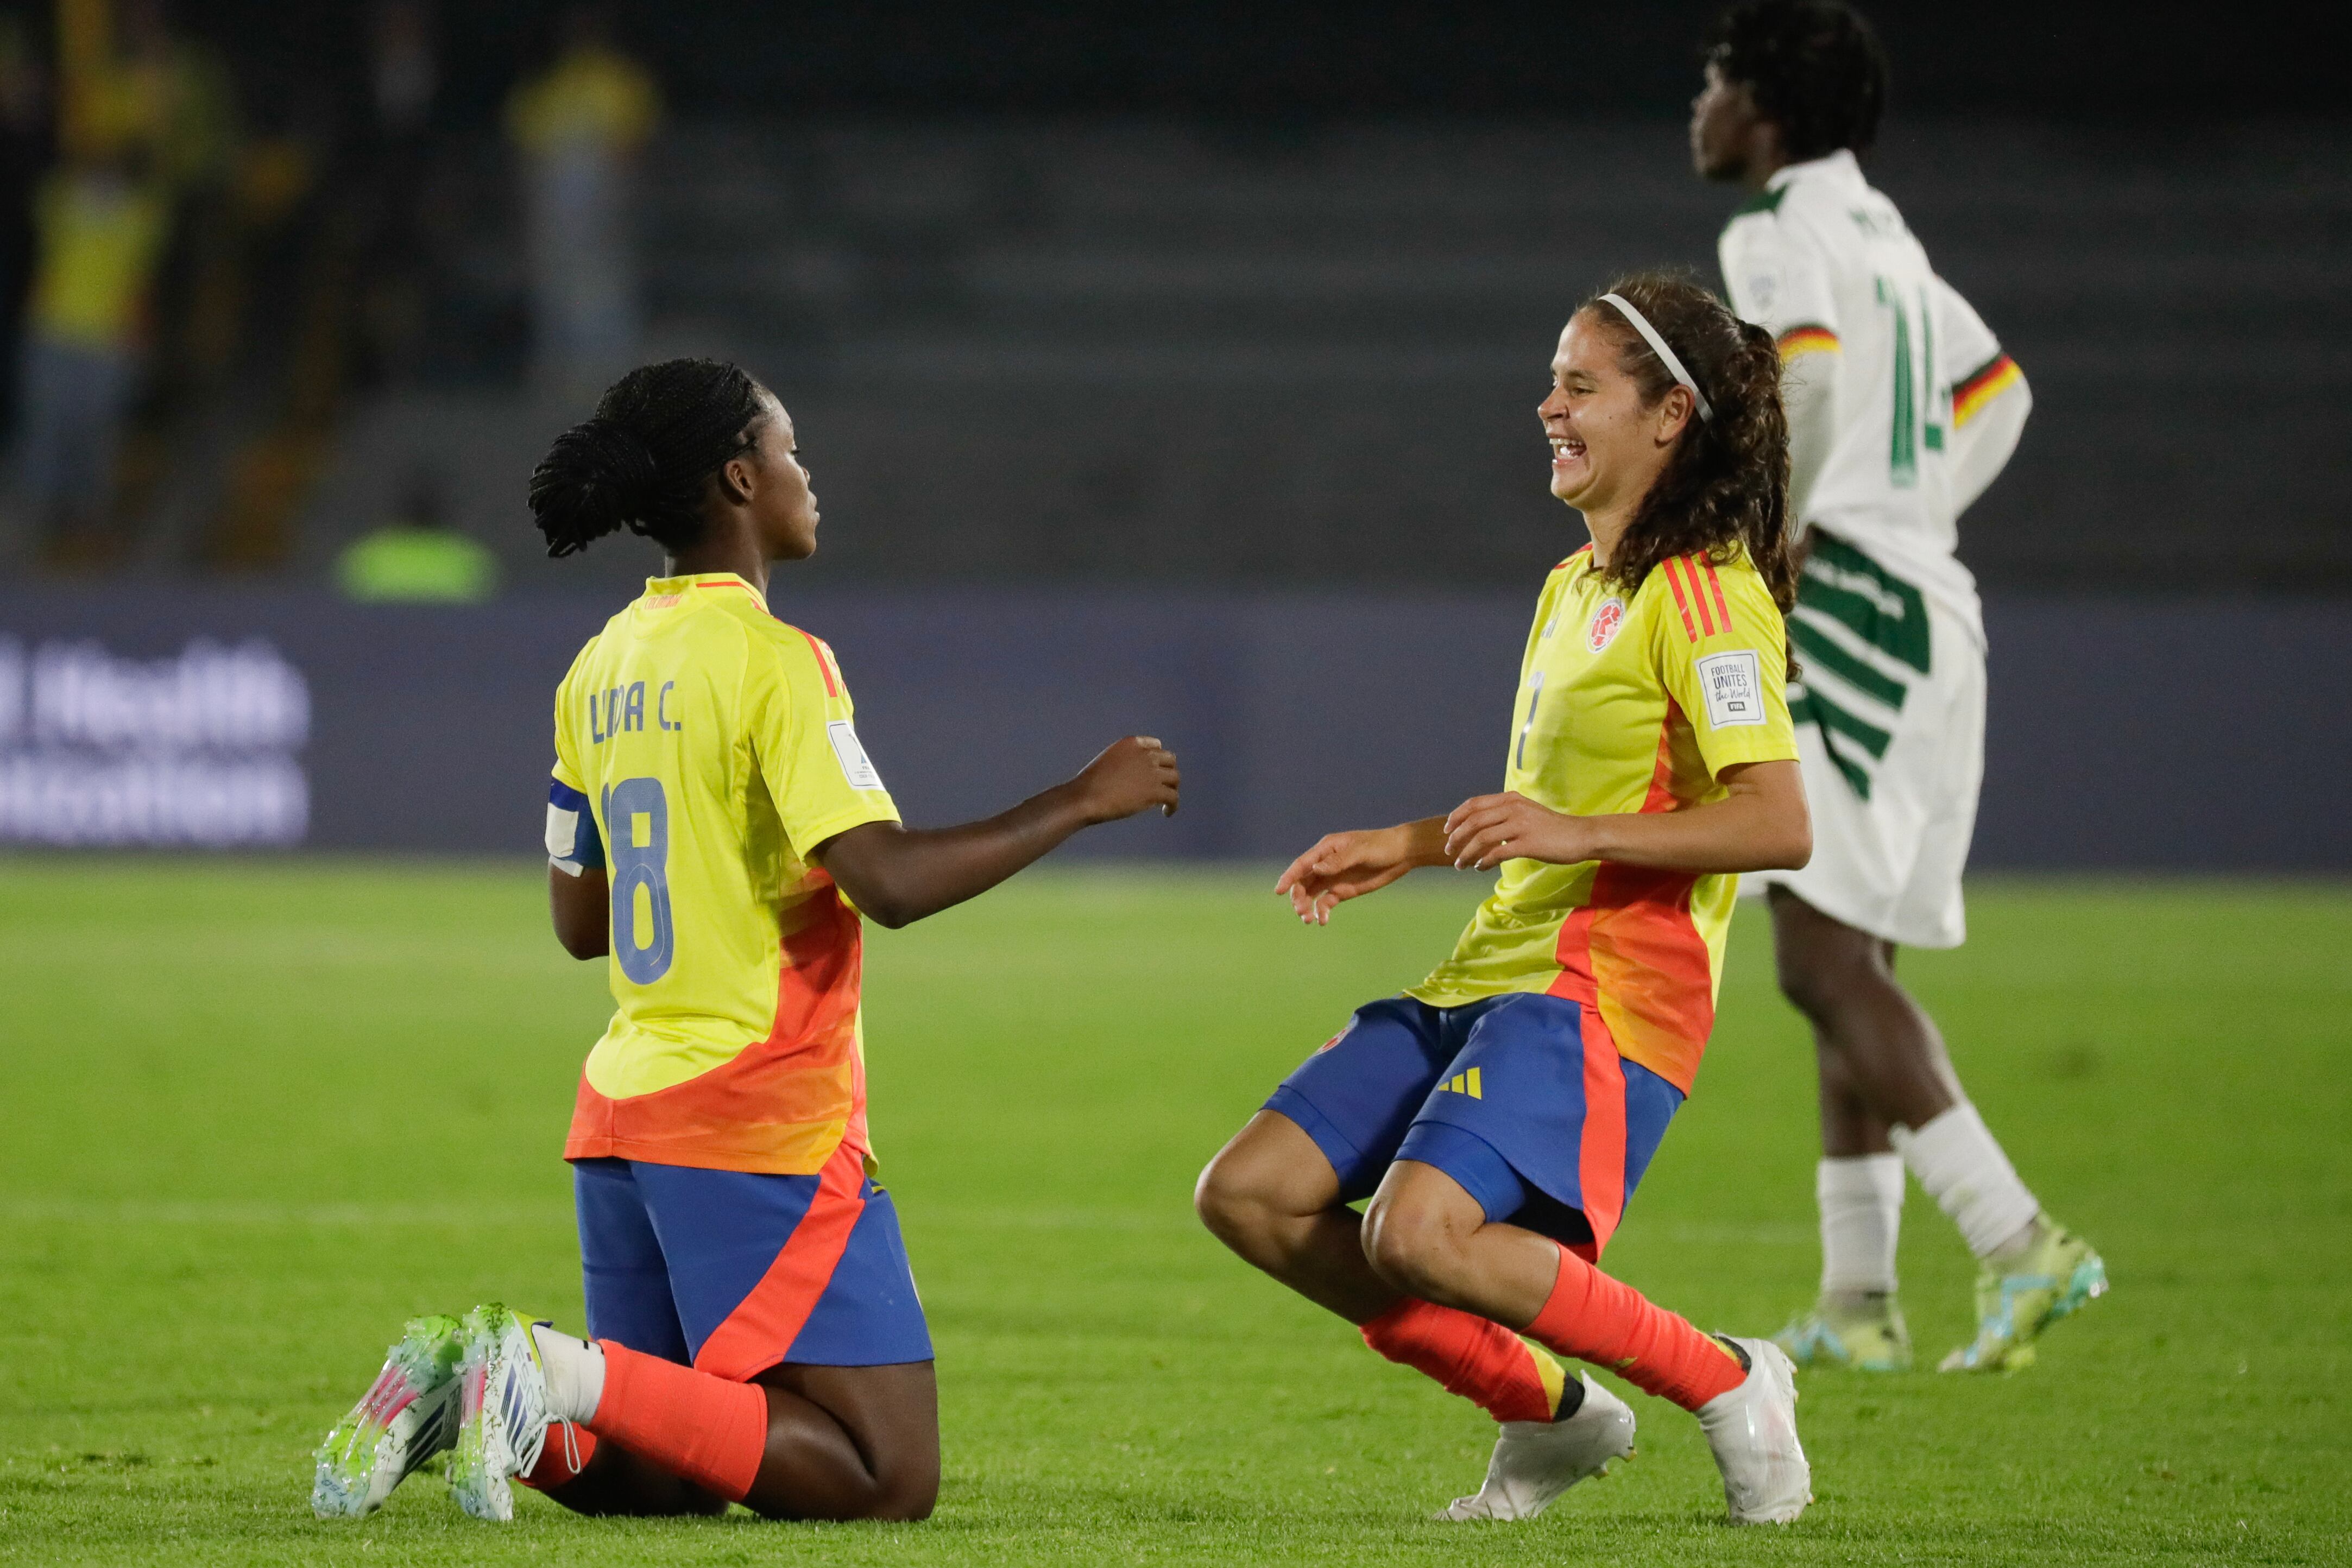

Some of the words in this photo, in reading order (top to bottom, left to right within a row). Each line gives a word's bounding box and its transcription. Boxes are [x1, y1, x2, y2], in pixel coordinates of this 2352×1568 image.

[1711, 664, 1745, 677] FOOTBALL
[1713, 674, 1747, 689] UNITES
[1715, 690, 1729, 701] the
[1730, 687, 1750, 699] World
[659, 680, 681, 731] C.
[1729, 703, 1745, 711] FIFA
